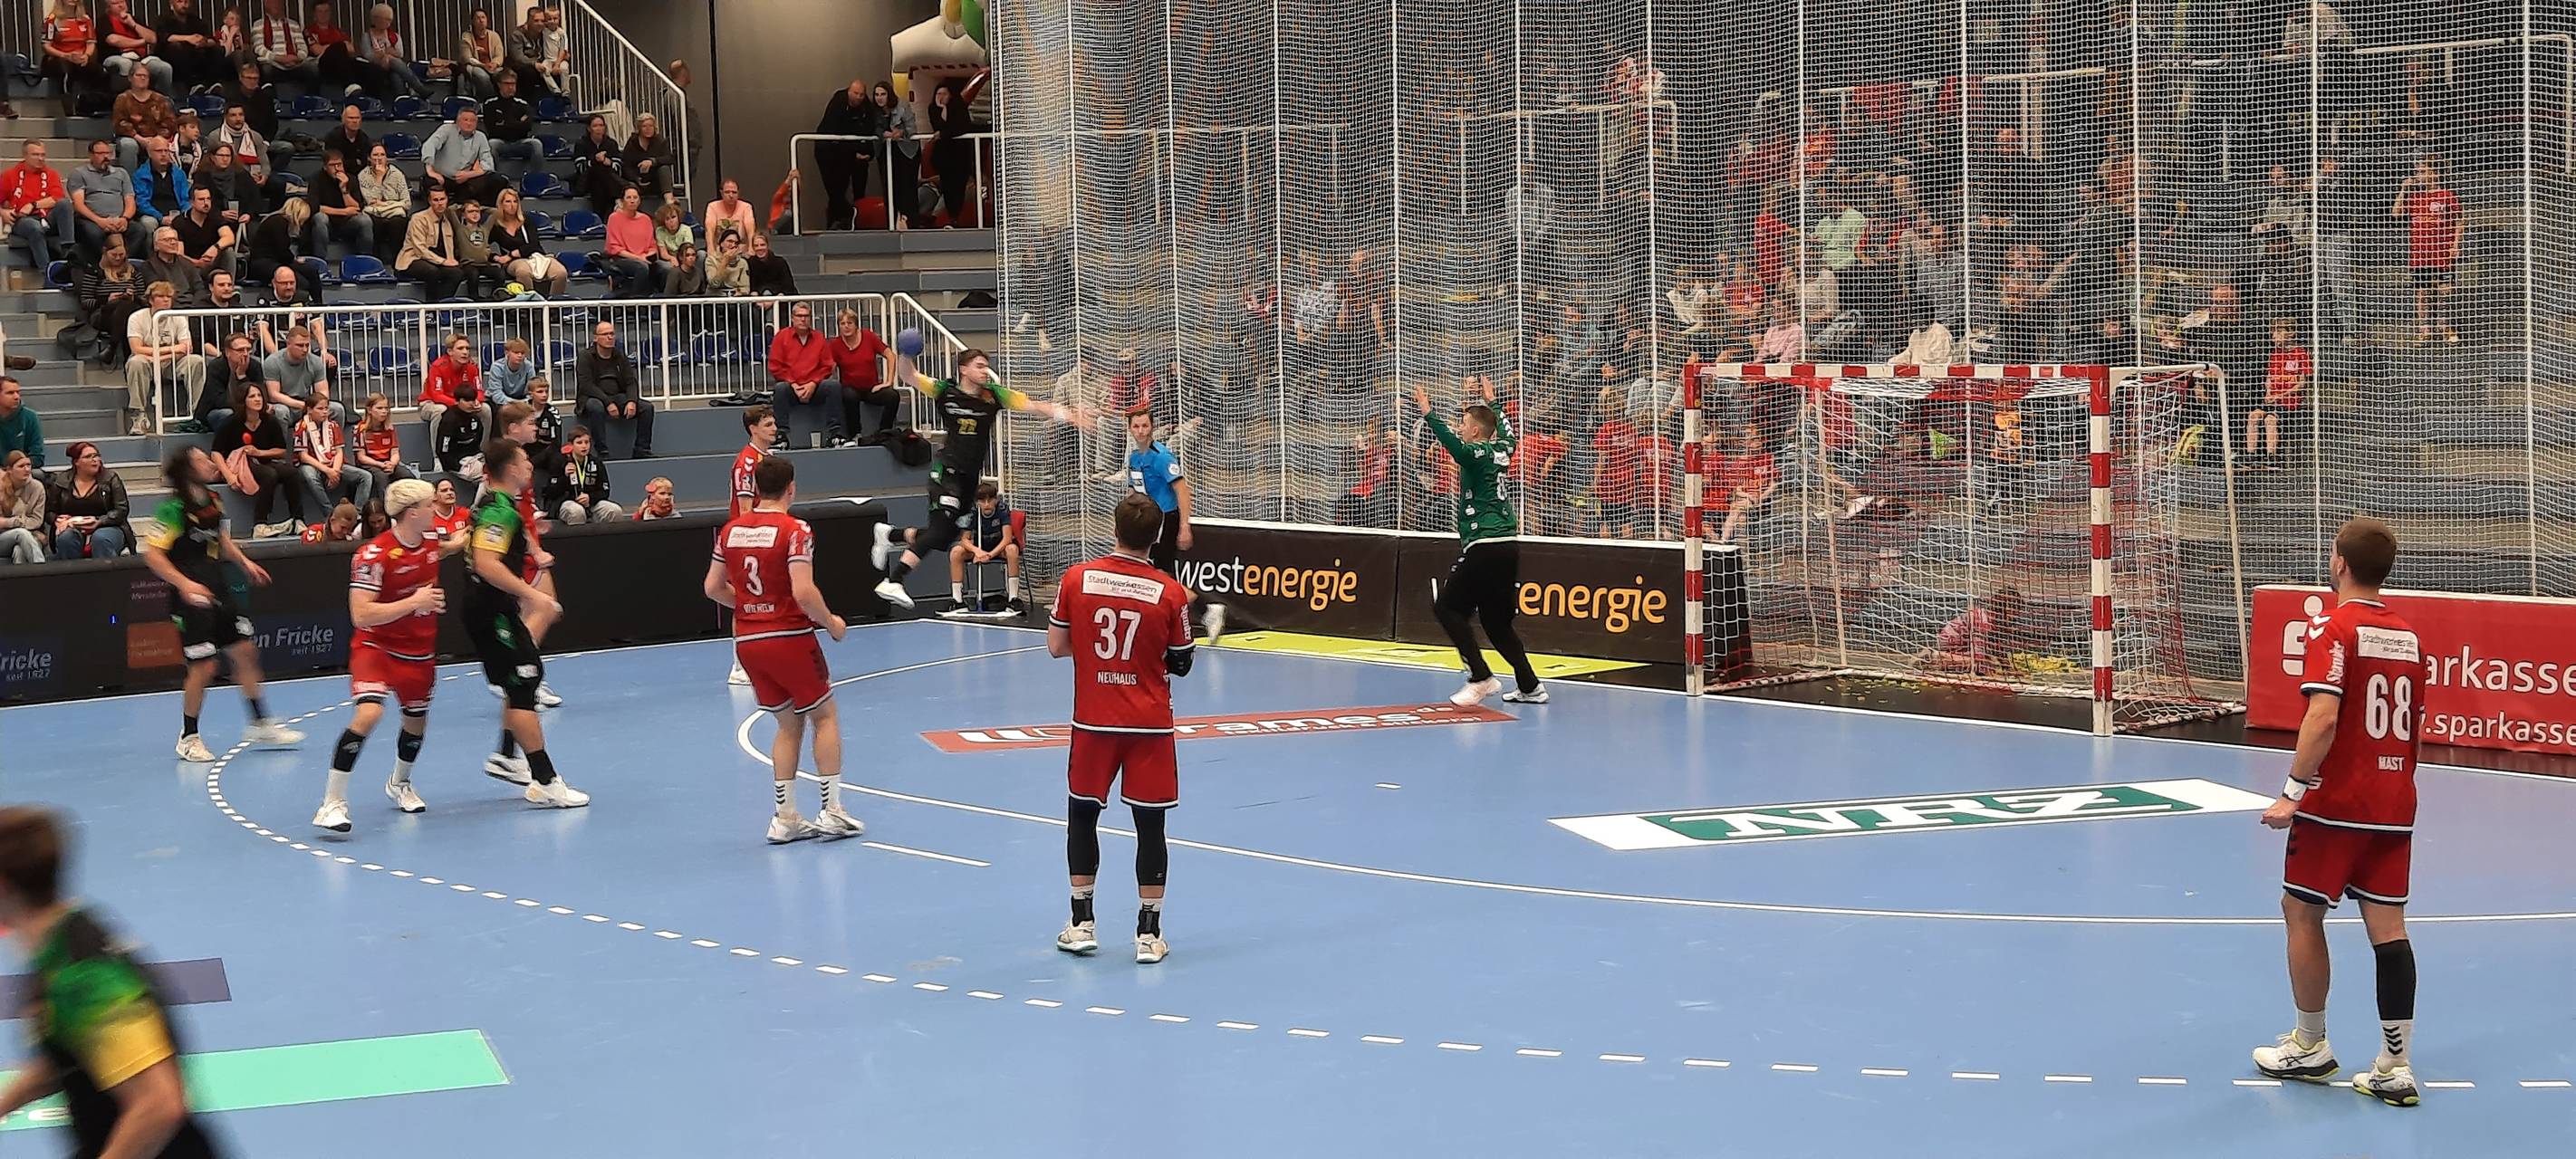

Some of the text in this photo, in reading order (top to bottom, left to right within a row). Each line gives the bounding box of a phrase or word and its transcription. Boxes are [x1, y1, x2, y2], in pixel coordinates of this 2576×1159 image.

[744, 555, 763, 596] 3
[1175, 556, 1357, 611] westenergie
[275, 625, 334, 646] Fricke
[1093, 607, 1141, 660] 37
[0, 648, 52, 670] ricke
[1098, 672, 1138, 685] NEUHAUS
[2425, 645, 2576, 696] arkasse
[2365, 673, 2412, 742] 68
[2378, 756, 2405, 771] MAST
[1670, 790, 2173, 838] NRZ
